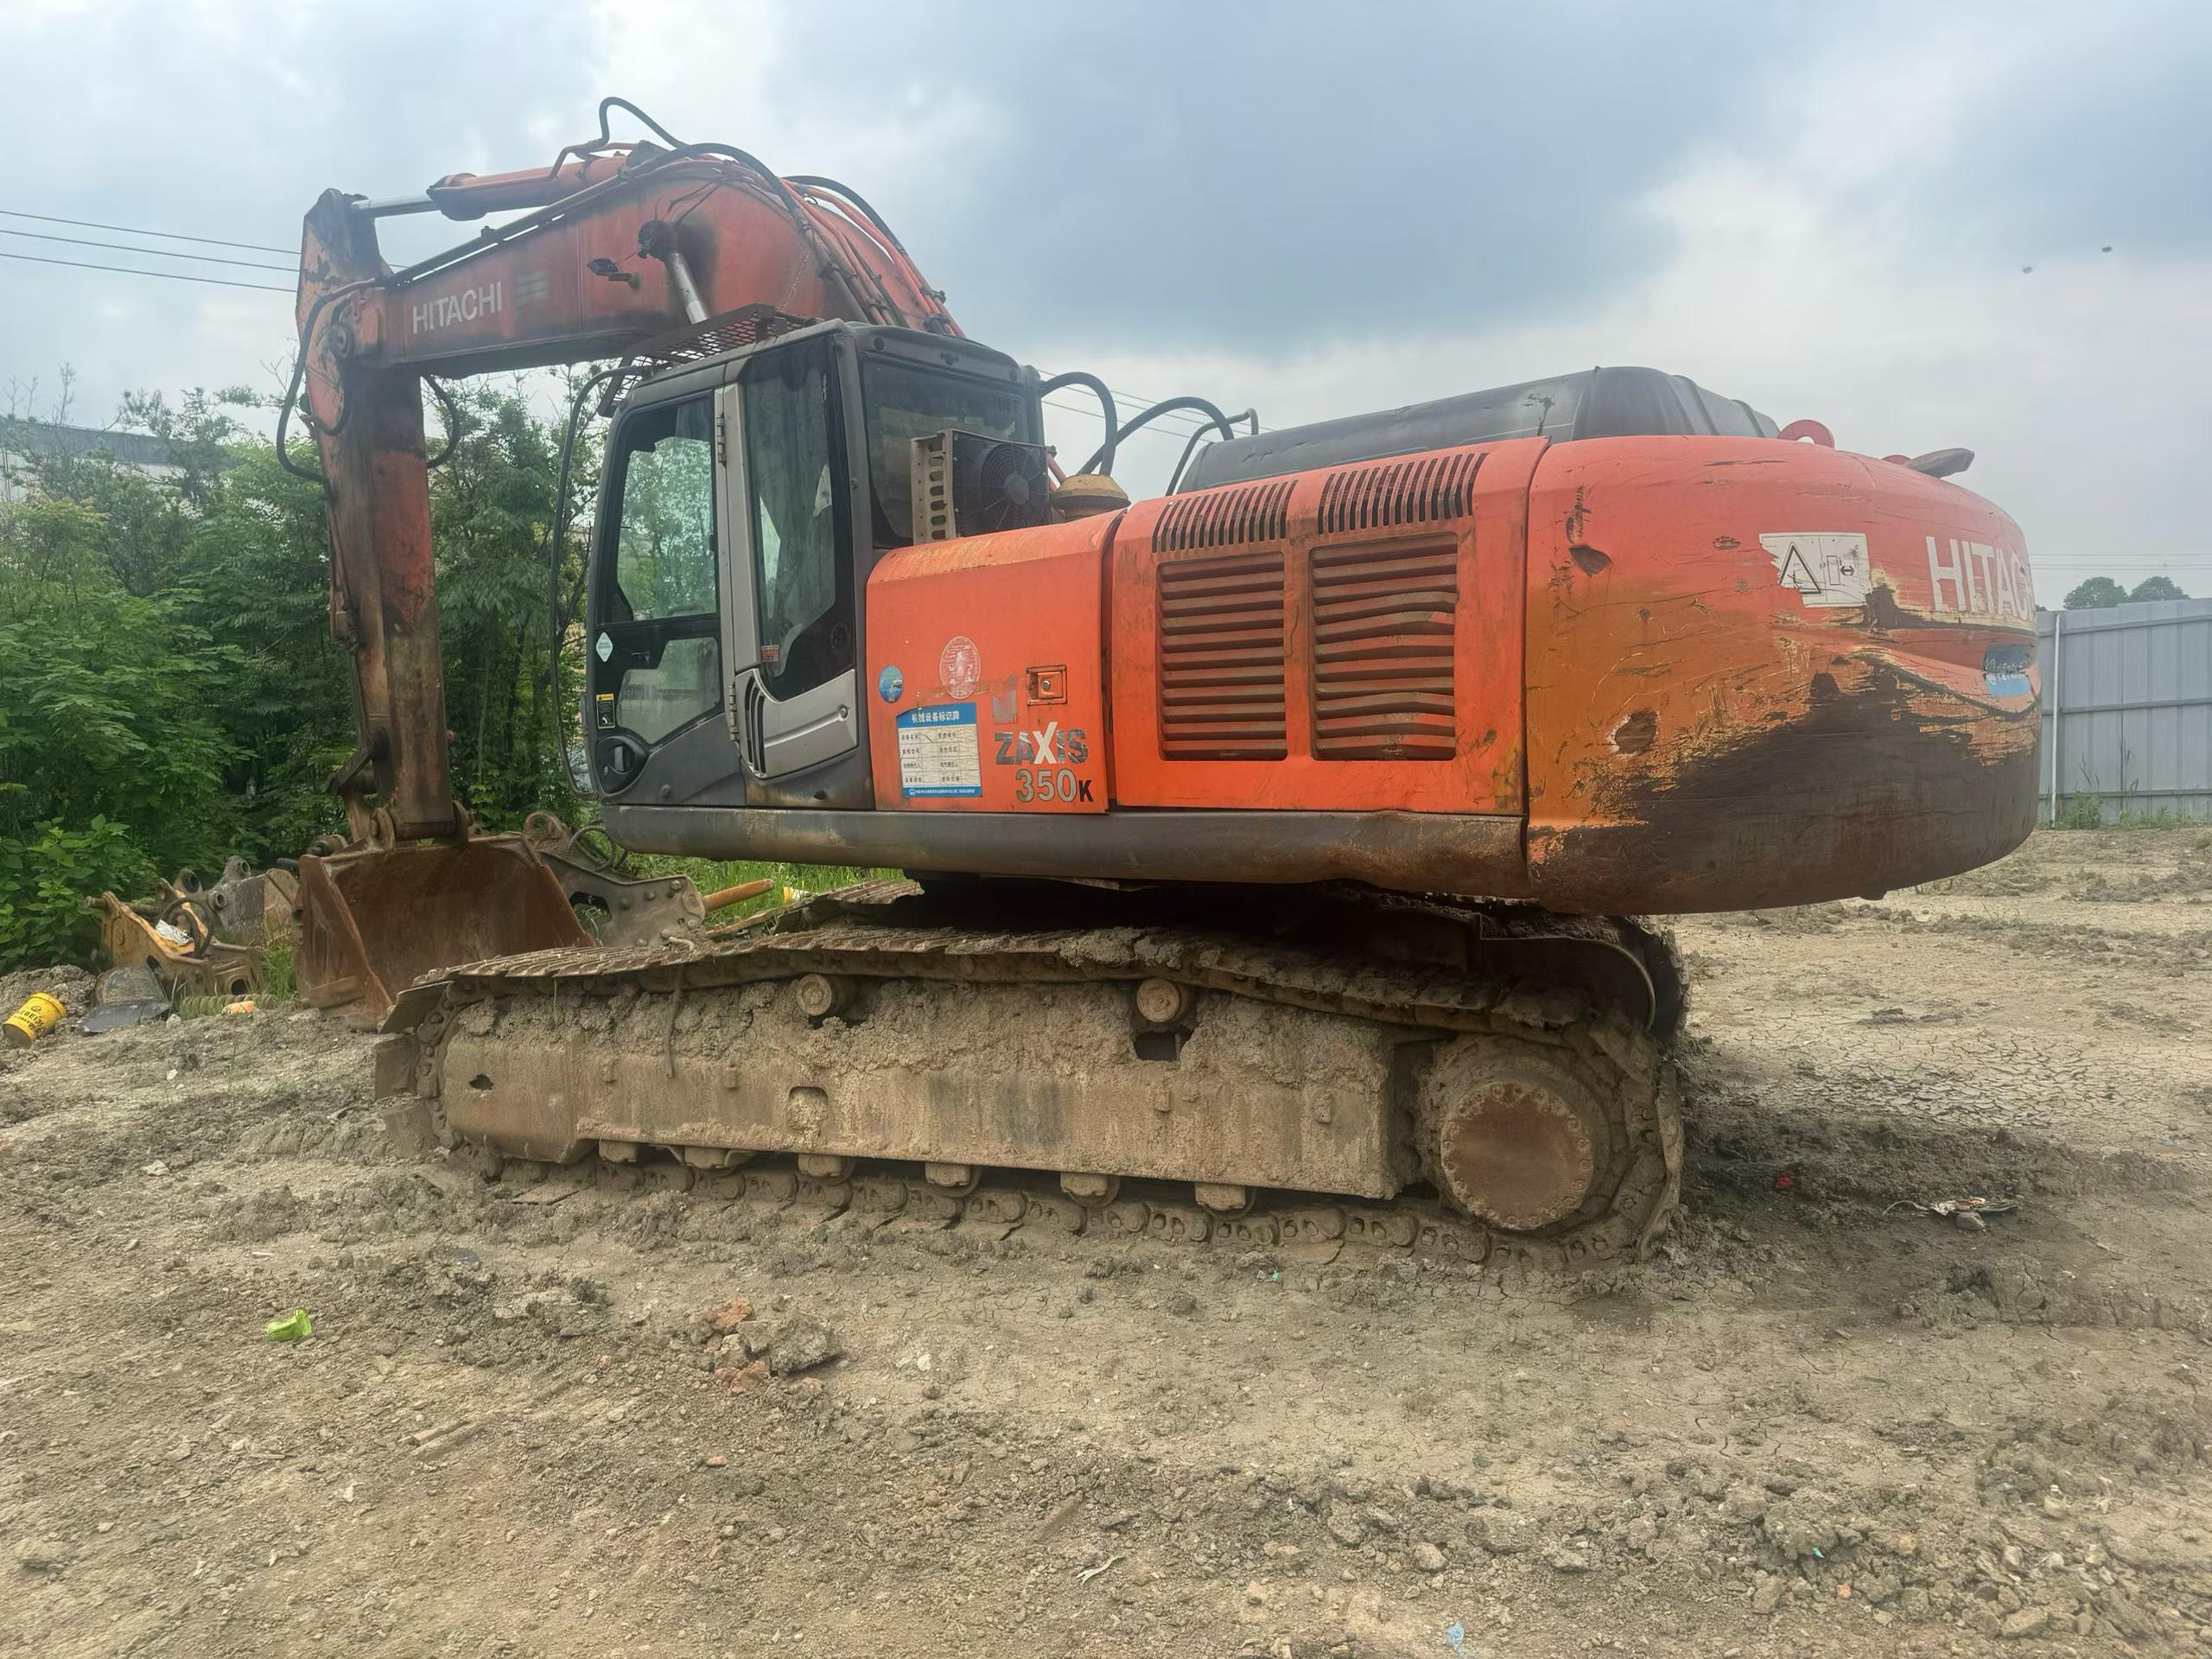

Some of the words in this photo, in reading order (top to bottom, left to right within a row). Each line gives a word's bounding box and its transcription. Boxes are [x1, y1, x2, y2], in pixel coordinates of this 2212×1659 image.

[412, 281, 503, 334] HITACHI
[912, 710, 960, 724] 机械设备标识牌
[994, 721, 1089, 766] ZAXIS
